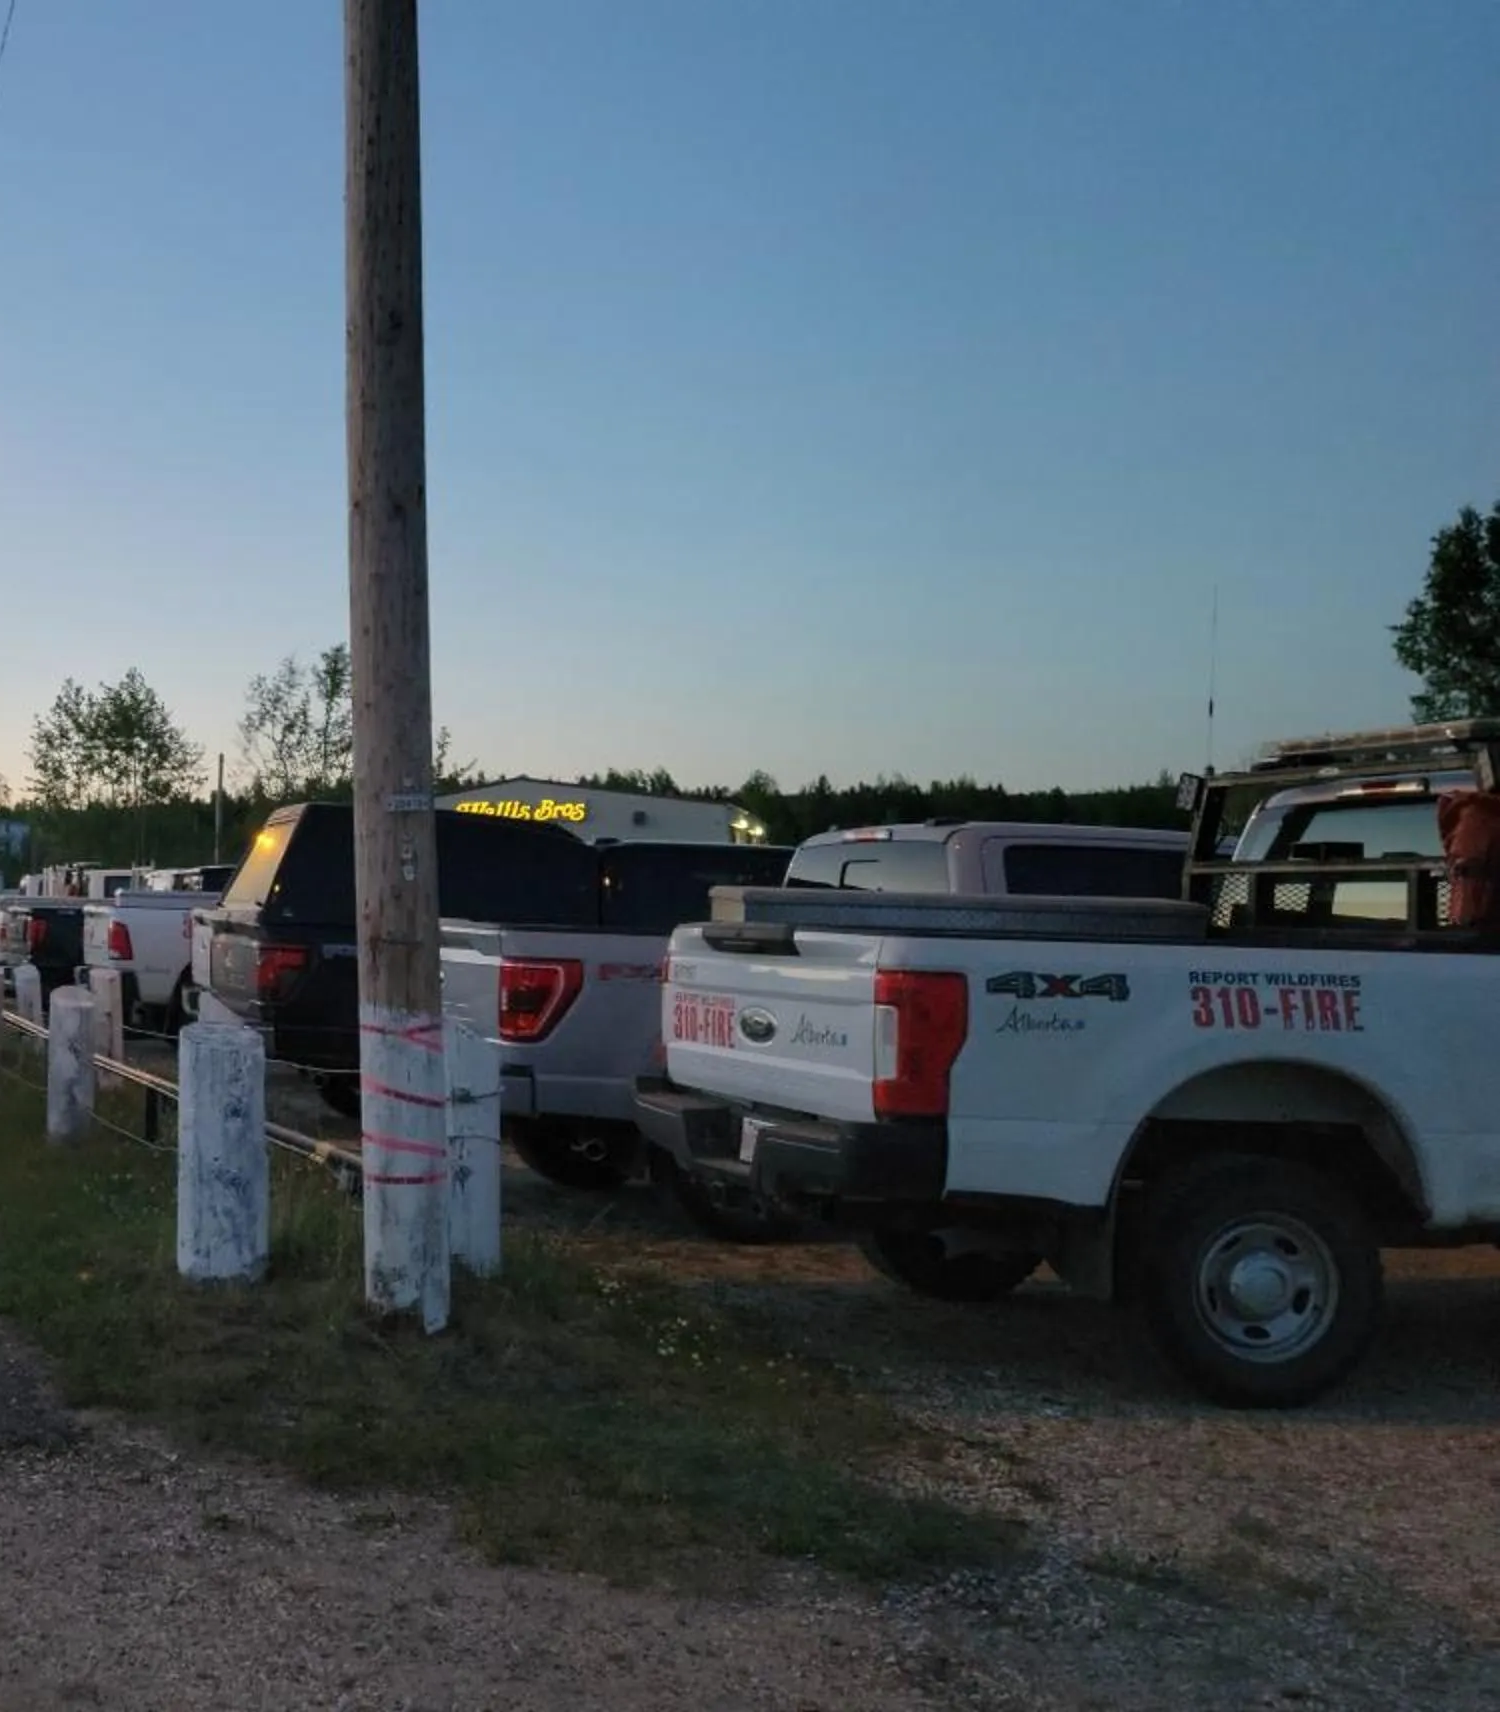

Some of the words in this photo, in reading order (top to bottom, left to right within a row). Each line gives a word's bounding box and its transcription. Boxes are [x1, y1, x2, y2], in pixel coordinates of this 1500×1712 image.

[534, 799, 587, 821] Bros
[1189, 971, 1258, 986] REPORT
[1265, 973, 1362, 988] WILDFIRES
[673, 1003, 735, 1048] 310-FIRE
[1191, 986, 1364, 1032] 310-FIRE
